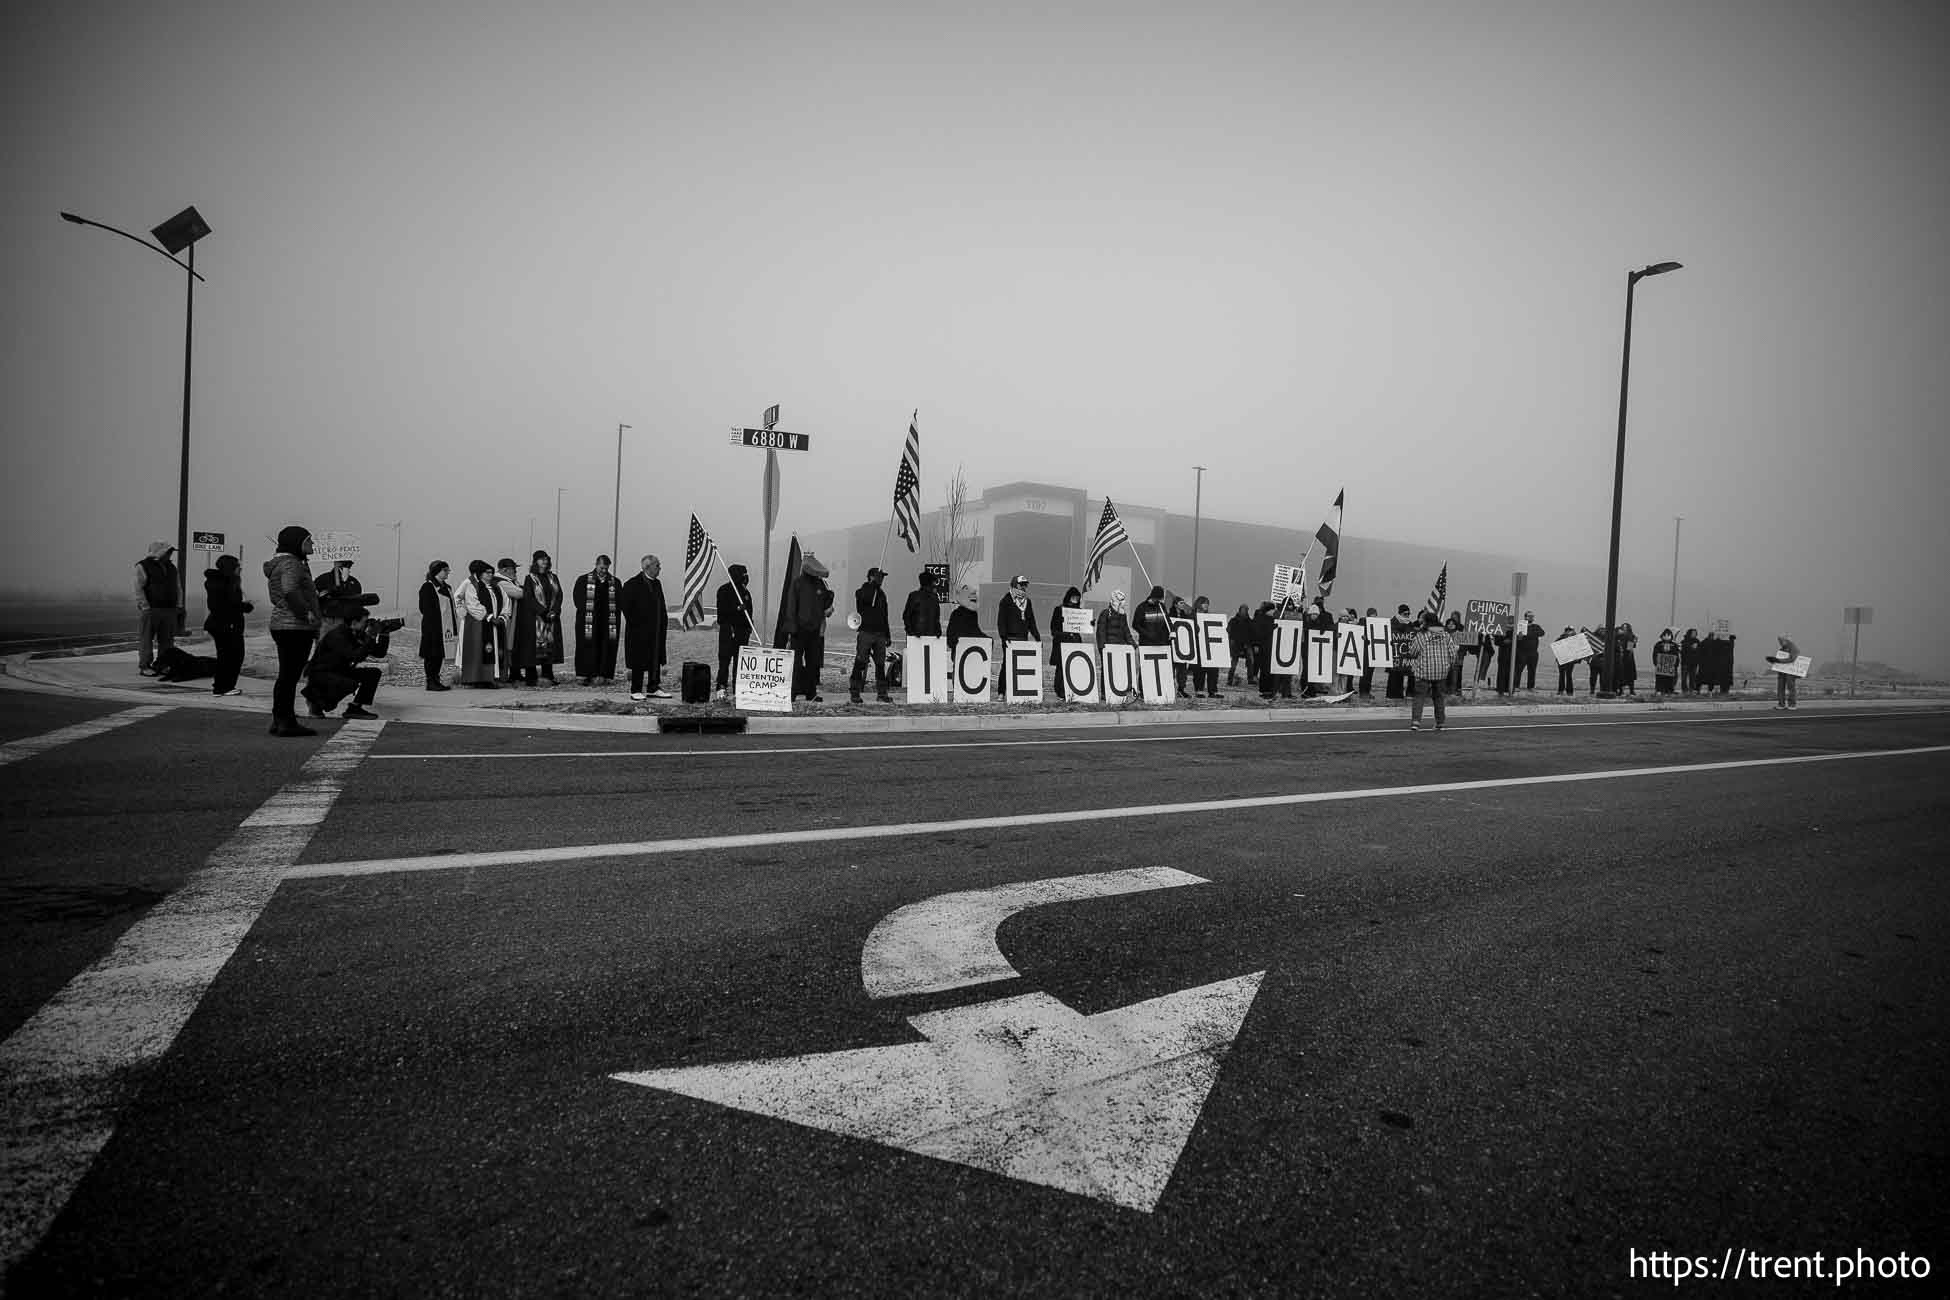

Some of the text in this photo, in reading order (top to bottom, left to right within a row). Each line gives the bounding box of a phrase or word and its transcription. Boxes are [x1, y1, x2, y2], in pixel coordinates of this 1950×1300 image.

[751, 431, 798, 449] 6880 W
[321, 552, 353, 560] ENERGY
[1470, 601, 1509, 616] CHINGA
[1479, 612, 1495, 624] TU
[1468, 619, 1504, 636] MAGA
[1392, 631, 1415, 641] MAKE
[740, 655, 784, 674] NO ICE
[923, 619, 1390, 697] ICE OUT OF UTAH
[740, 673, 785, 684] DETENTION
[749, 680, 778, 689] CAMP
